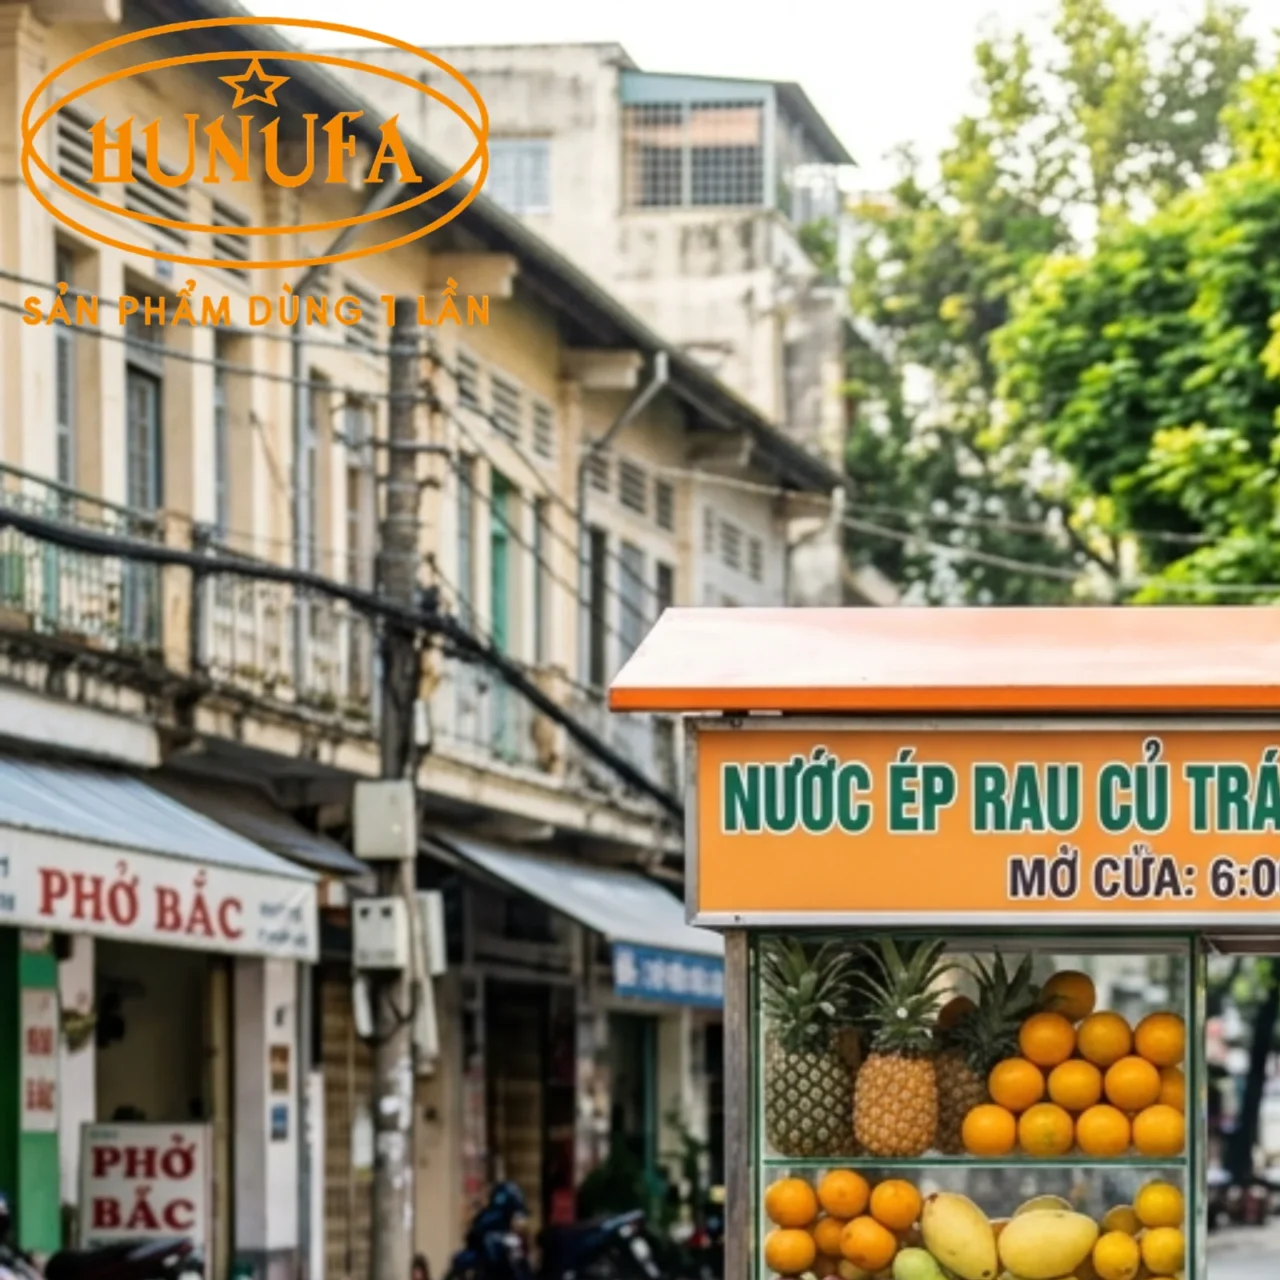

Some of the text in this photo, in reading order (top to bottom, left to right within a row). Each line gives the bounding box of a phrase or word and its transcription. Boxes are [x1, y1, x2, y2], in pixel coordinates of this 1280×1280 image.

[723, 747, 871, 832] NƯỚC
[888, 748, 956, 832] ÉP
[973, 763, 1081, 832] RAU
[1099, 738, 1169, 832] CỦ
[38, 860, 243, 940] PHỞ BẮC
[1009, 844, 1079, 897] MỞ
[91, 1132, 196, 1179] PHỞ
